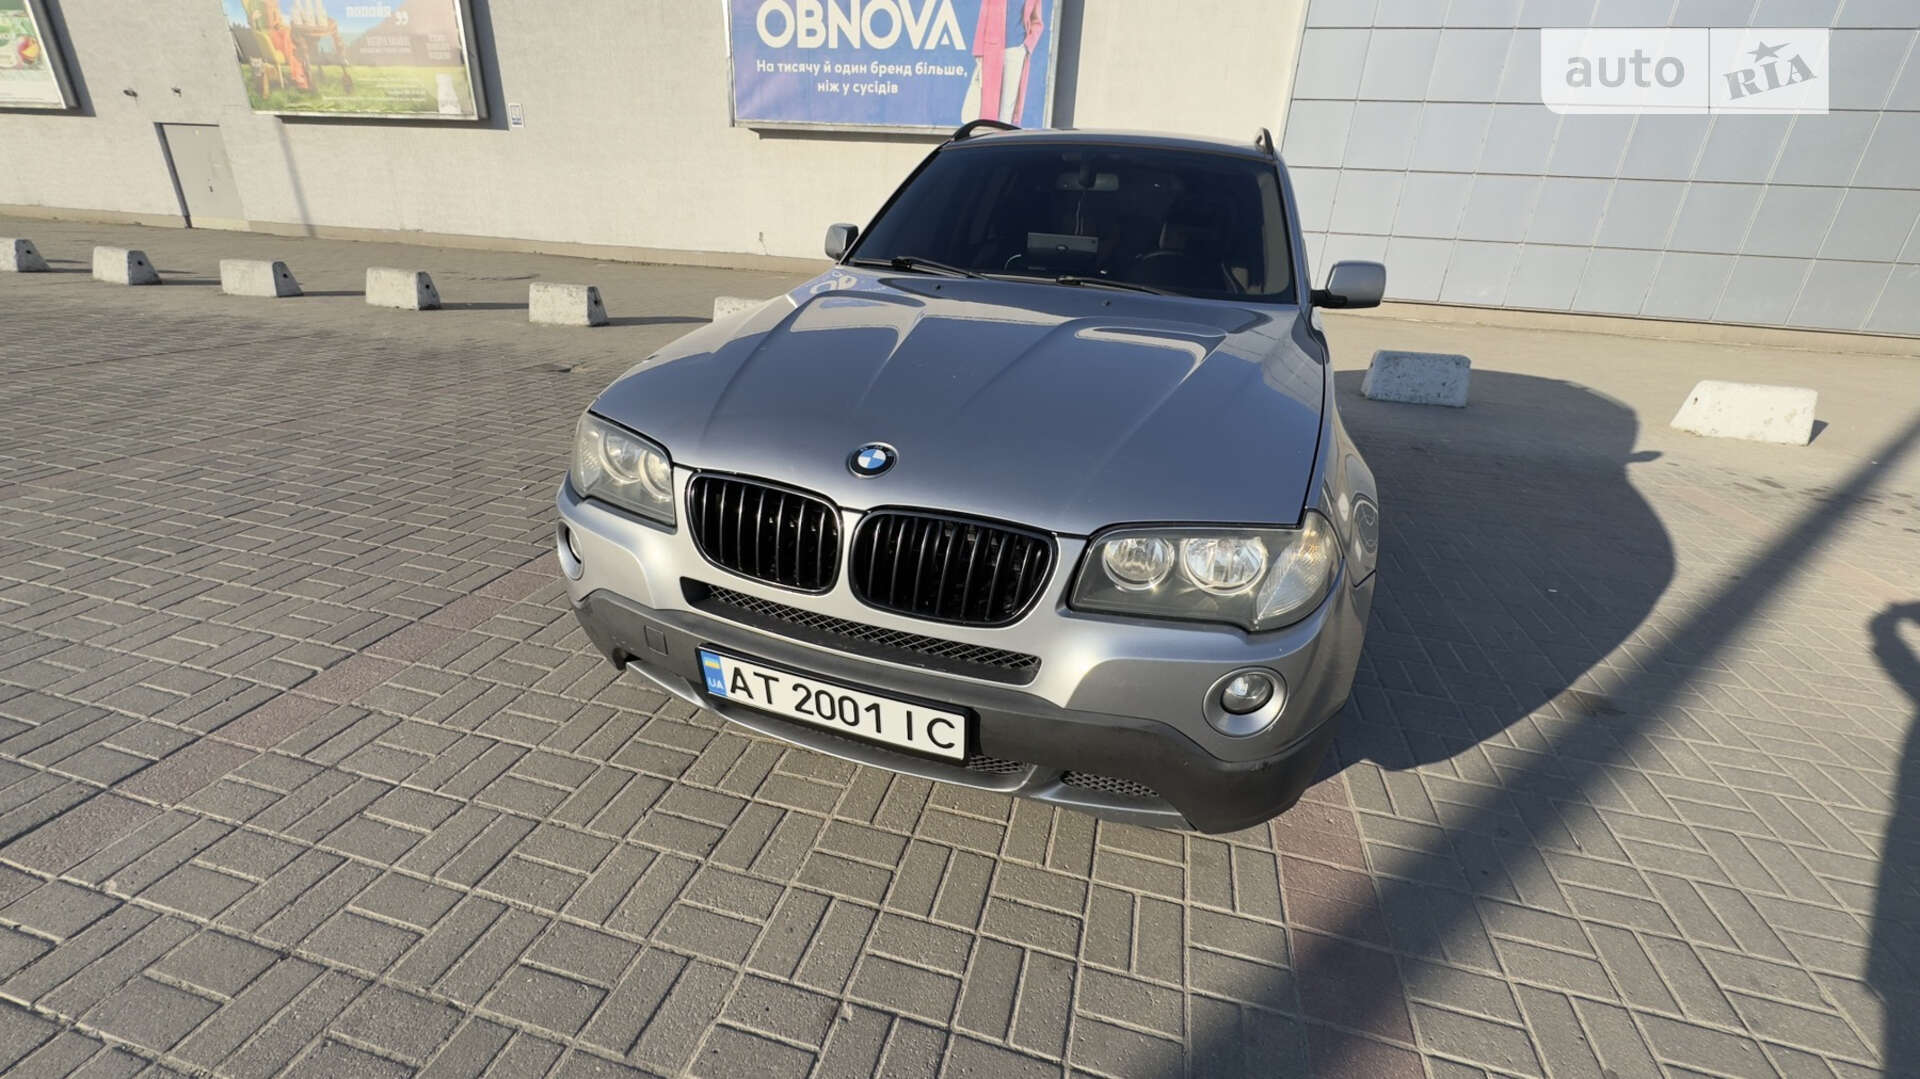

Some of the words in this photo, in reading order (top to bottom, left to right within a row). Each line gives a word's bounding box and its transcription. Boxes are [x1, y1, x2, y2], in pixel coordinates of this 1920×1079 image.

[756, 0, 967, 50] OBNOVA
[756, 60, 774, 73] На
[777, 62, 820, 76] тисячу
[824, 61, 832, 74] й
[834, 63, 867, 75] один
[870, 61, 912, 76] бренд
[915, 62, 968, 77] більше,
[817, 80, 840, 93] ніж
[842, 83, 851, 96] у
[852, 81, 899, 96] сусідів
[708, 677, 725, 690] UA
[730, 667, 780, 705] AT
[792, 683, 882, 734] 2001
[906, 710, 956, 749] IC
